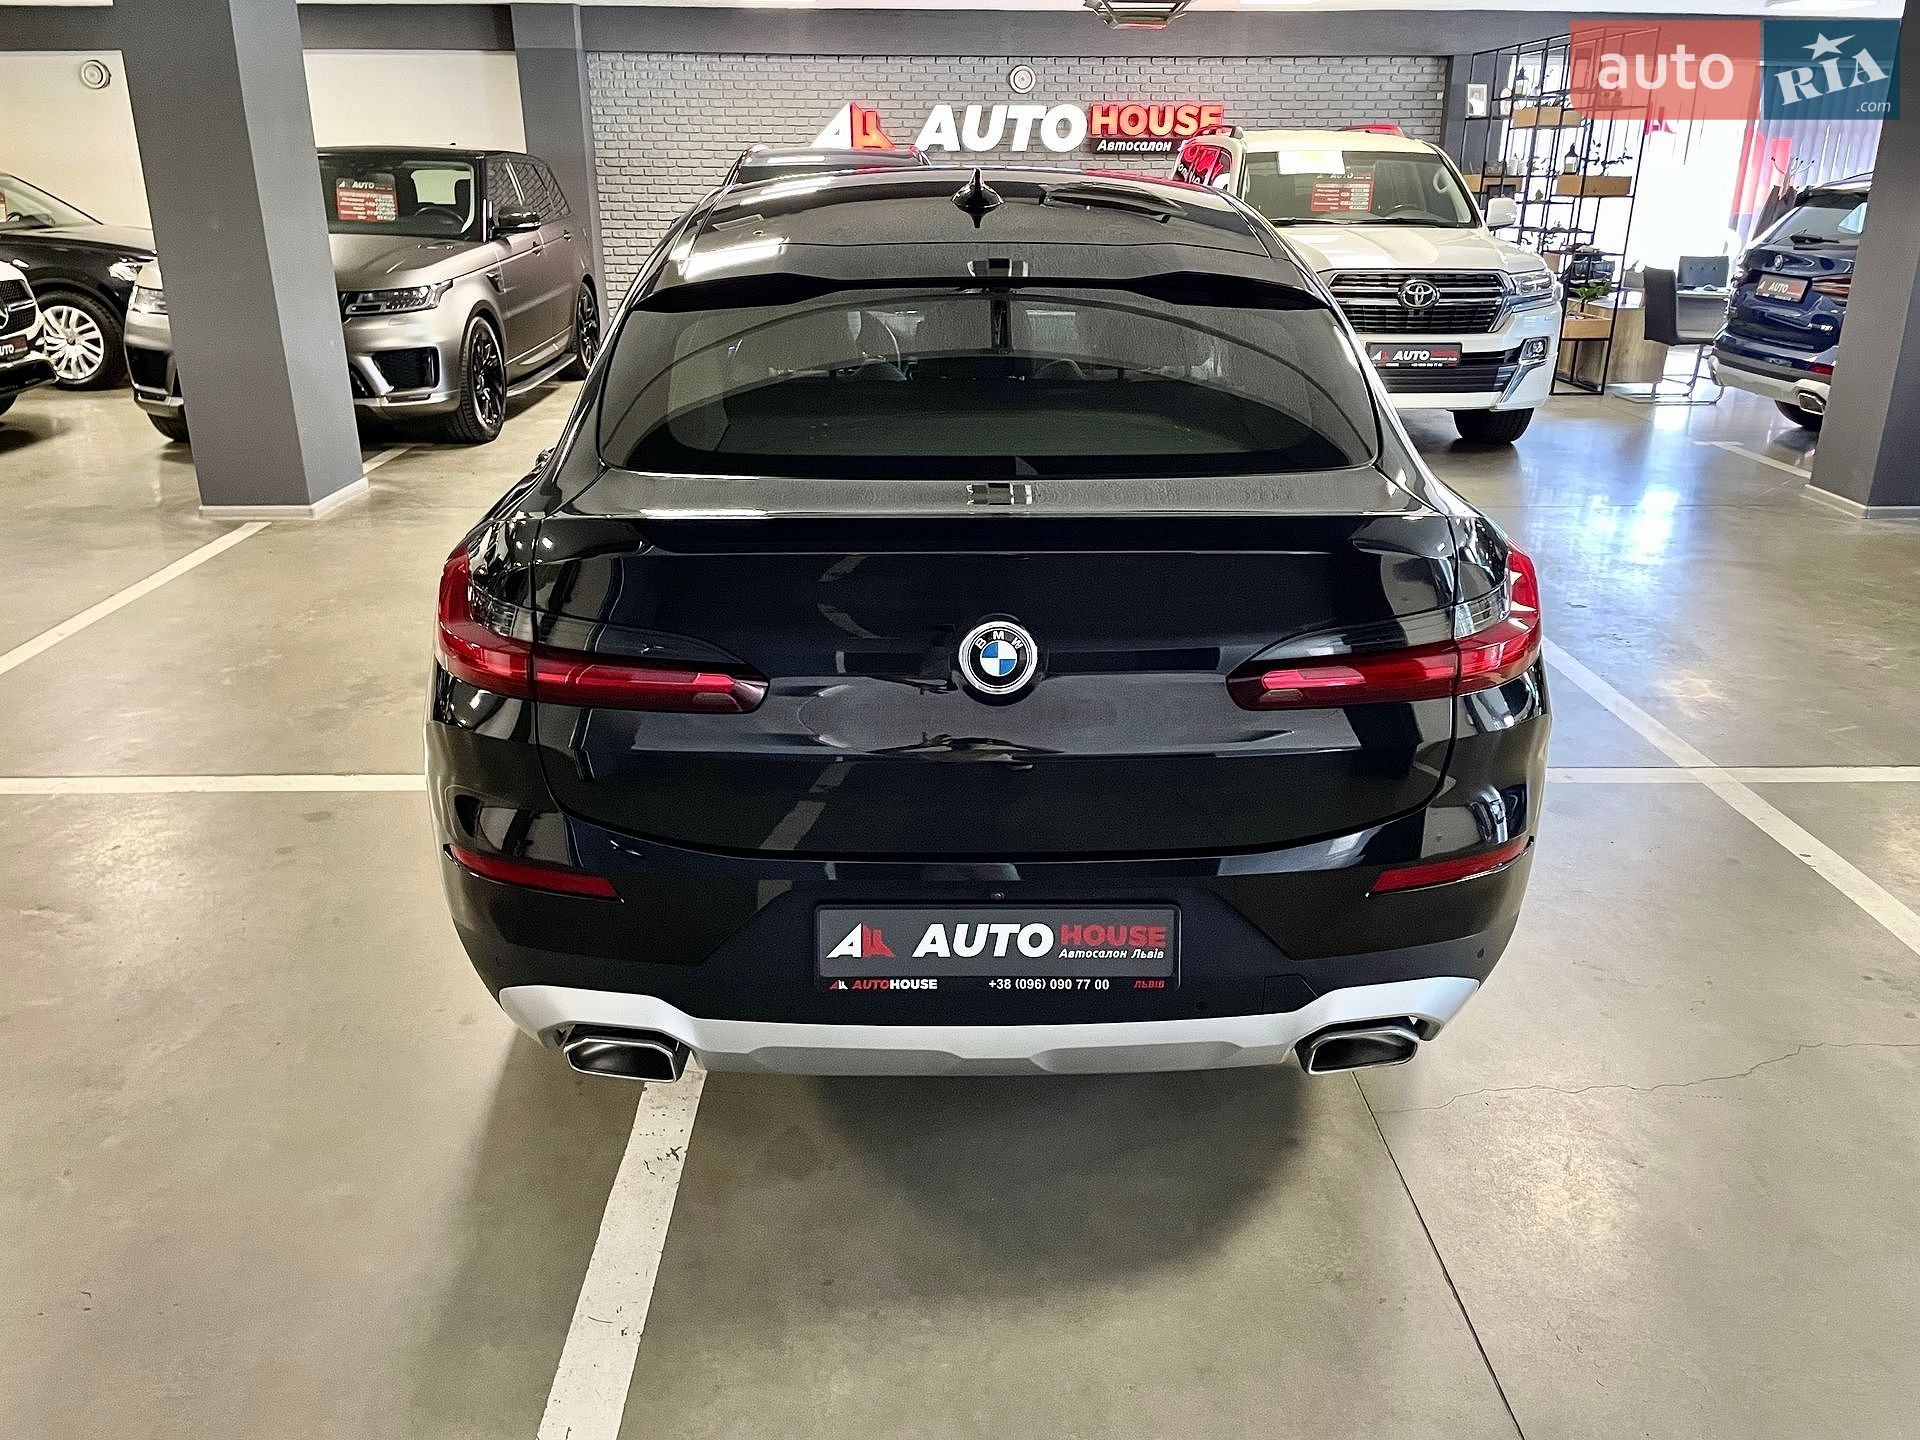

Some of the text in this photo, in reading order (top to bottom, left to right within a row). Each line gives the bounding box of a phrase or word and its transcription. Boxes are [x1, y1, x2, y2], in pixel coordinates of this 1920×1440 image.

[913, 104, 1088, 153] AUTO
[1090, 103, 1224, 136] HOUSE
[1096, 140, 1173, 152] Автосалон
[1768, 282, 1789, 293] AUTO
[1392, 350, 1430, 361] AUTO
[974, 630, 1024, 650] BMW
[911, 922, 1055, 958] AUTO
[1060, 923, 1167, 948] HOUSE
[1059, 948, 1165, 959] Автосалон Львів
[852, 979, 938, 990] AUTOHOUSE
[988, 978, 1110, 991] +38 (096) 090 77 00
